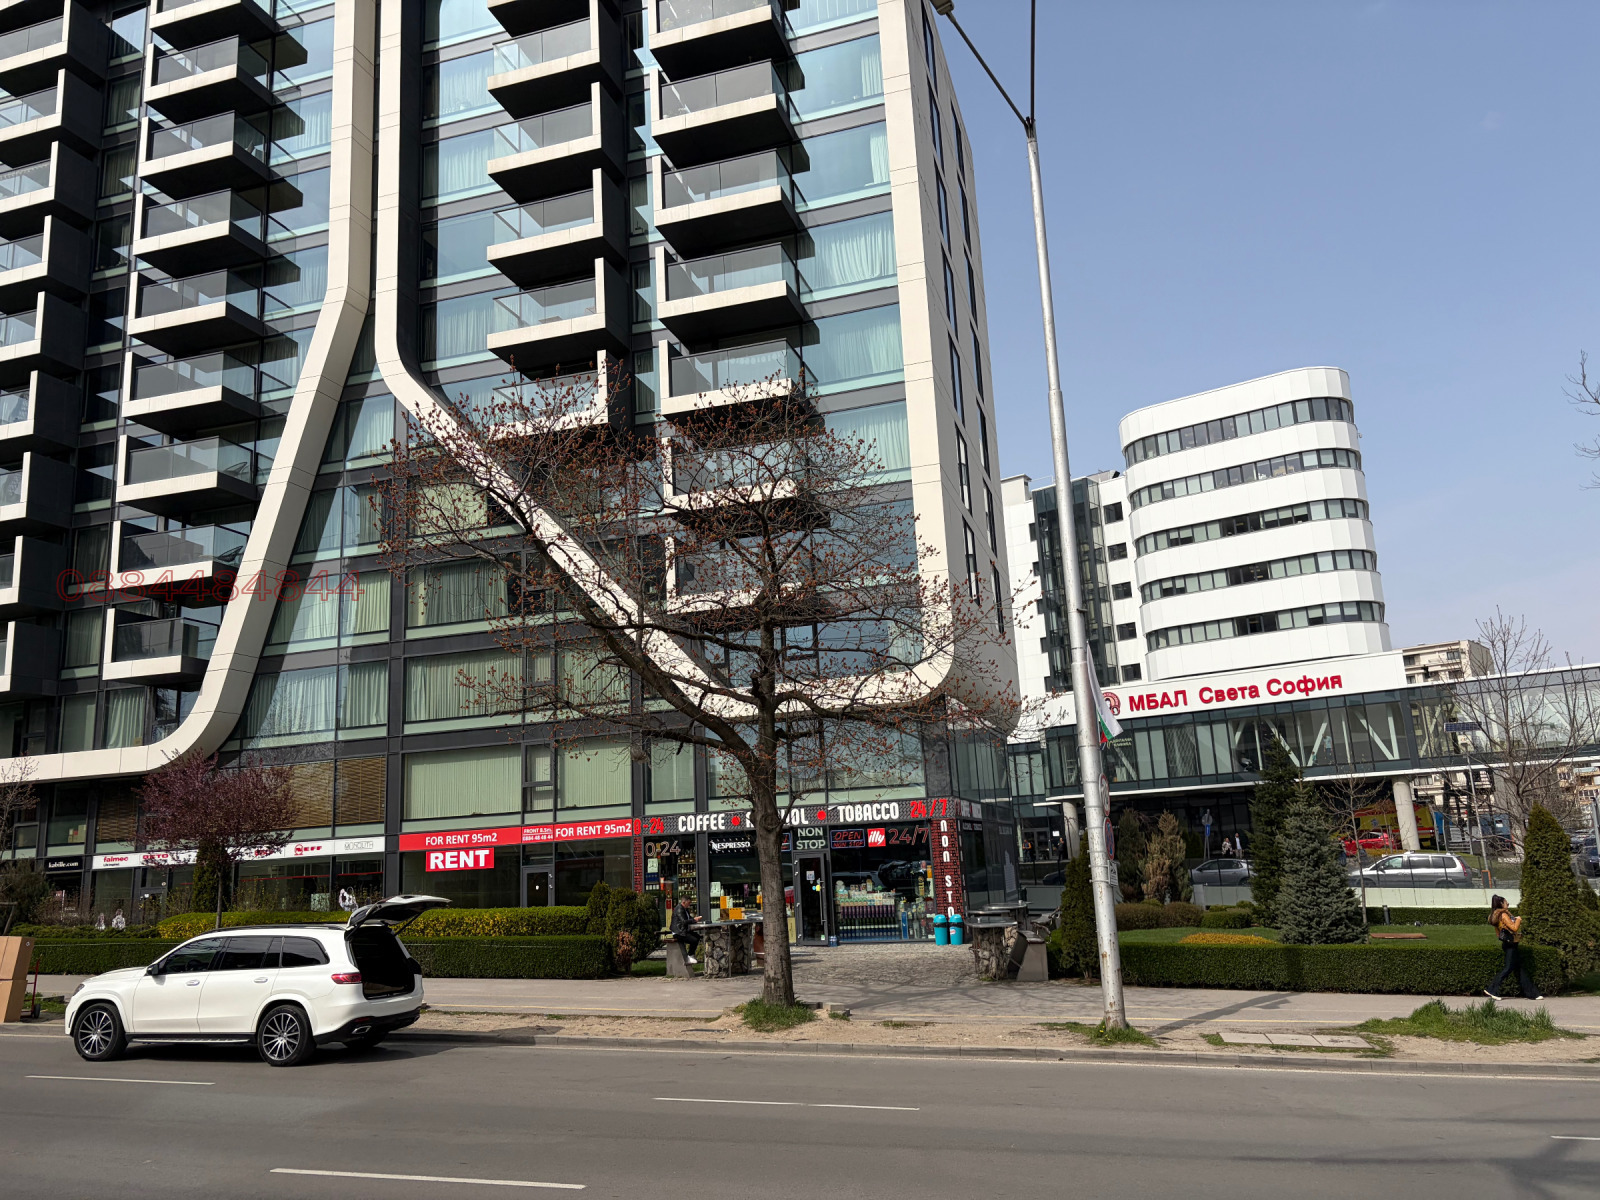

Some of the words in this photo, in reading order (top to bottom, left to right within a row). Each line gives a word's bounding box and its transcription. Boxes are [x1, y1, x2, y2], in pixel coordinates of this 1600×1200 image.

[1128, 690, 1188, 712] МБАЛ
[1198, 684, 1260, 704] Света
[1266, 674, 1343, 696] София
[679, 814, 725, 831] COFFEE
[838, 803, 899, 821] TOBACCO
[555, 828, 574, 838] FOR
[576, 825, 602, 836] RENT
[604, 823, 632, 834] 95m2
[797, 826, 823, 837] NON
[834, 830, 862, 841] OPEN
[868, 830, 885, 845] illy
[425, 836, 443, 846] FOR
[446, 834, 470, 845] RENT
[471, 832, 498, 843] 95m2
[710, 840, 751, 851] NESPRESSO
[796, 839, 826, 850] STOP
[430, 850, 489, 869] RENT
[945, 875, 955, 917] STO
